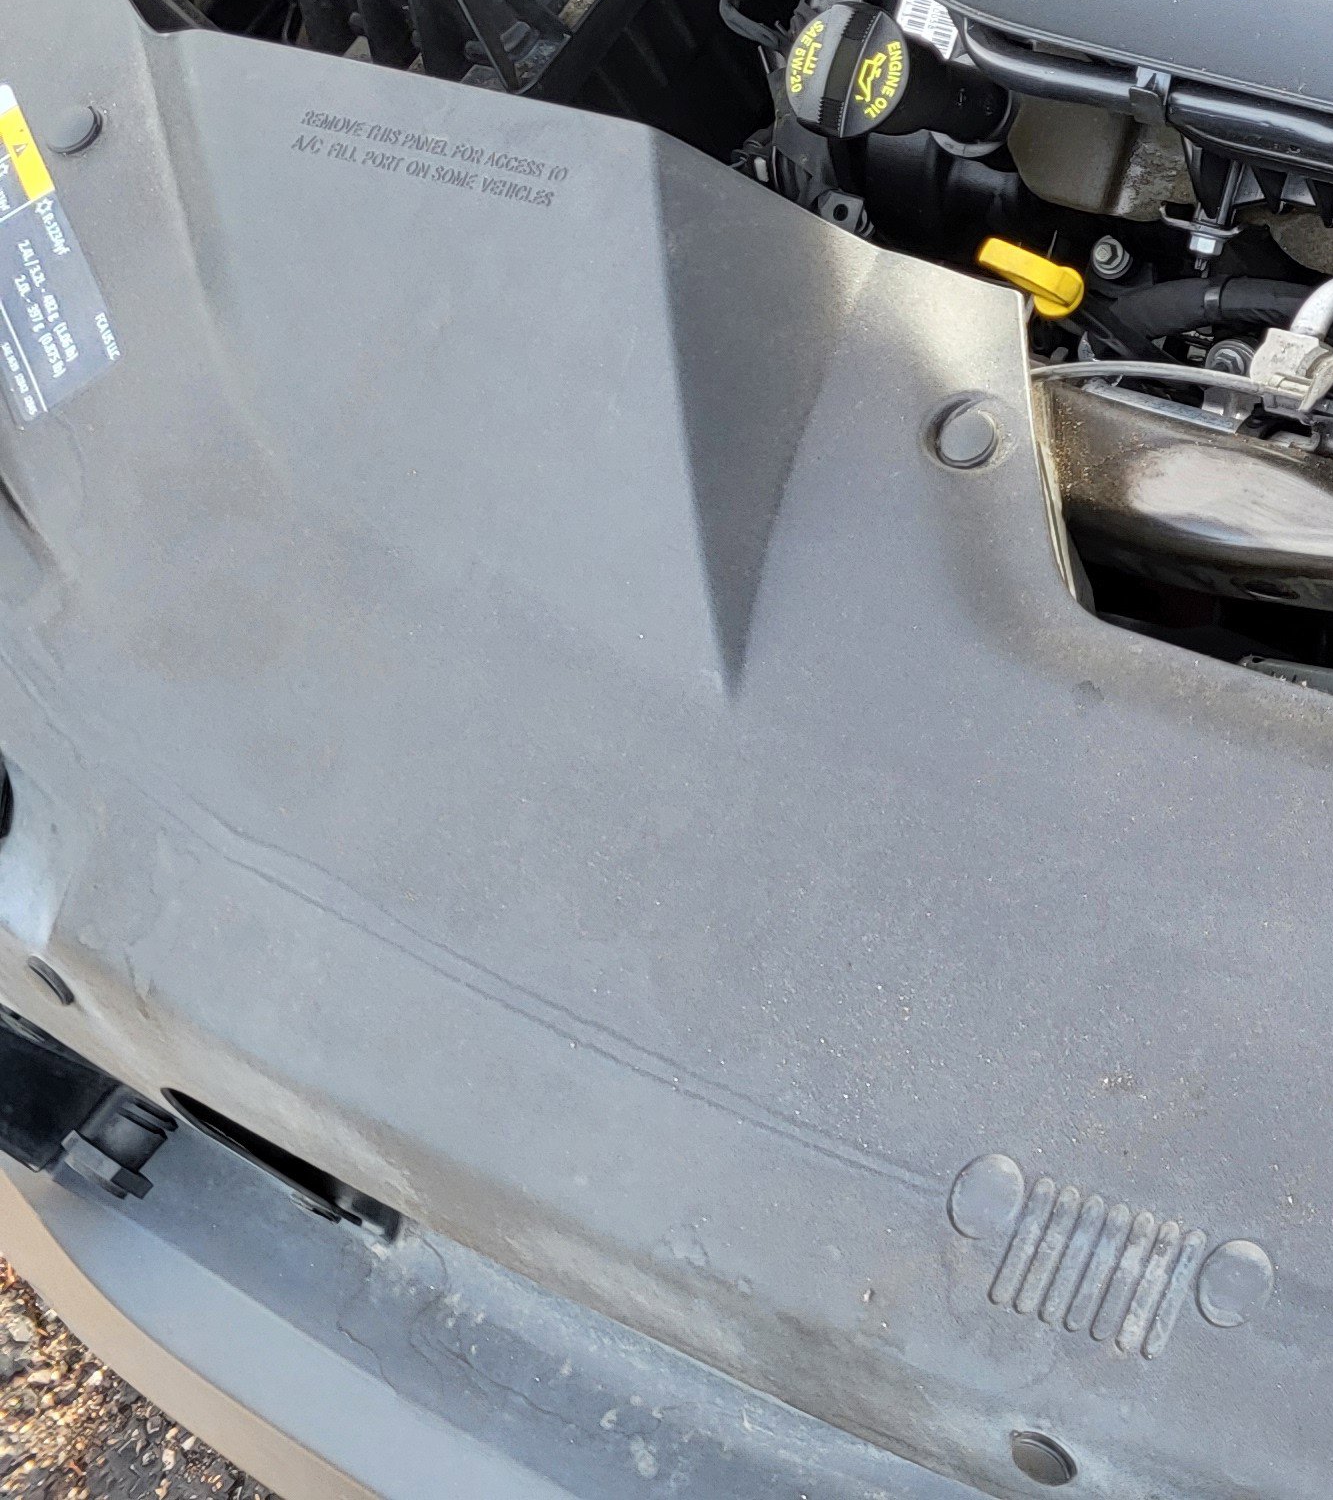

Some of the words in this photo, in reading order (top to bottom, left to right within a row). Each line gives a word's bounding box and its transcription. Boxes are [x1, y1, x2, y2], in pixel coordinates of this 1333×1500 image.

[800, 21, 825, 46] SAE
[790, 48, 805, 93] 5W-20
[881, 40, 903, 97] ENGINE
[864, 97, 888, 120] OIL
[301, 109, 369, 137] REMOVE
[366, 123, 402, 145] THIS
[401, 132, 450, 157] PANEL
[451, 143, 484, 165] FOR
[483, 151, 546, 176] ACCESS
[547, 165, 569, 182] TO
[291, 134, 325, 154] A/C
[327, 142, 358, 163] FILL
[361, 149, 405, 172] PORT
[405, 159, 431, 179] ON
[431, 165, 479, 190] SOME
[481, 175, 555, 207] VEHICLES
[94, 312, 110, 333] FCA
[101, 329, 115, 345] US
[106, 342, 121, 361] LLC
